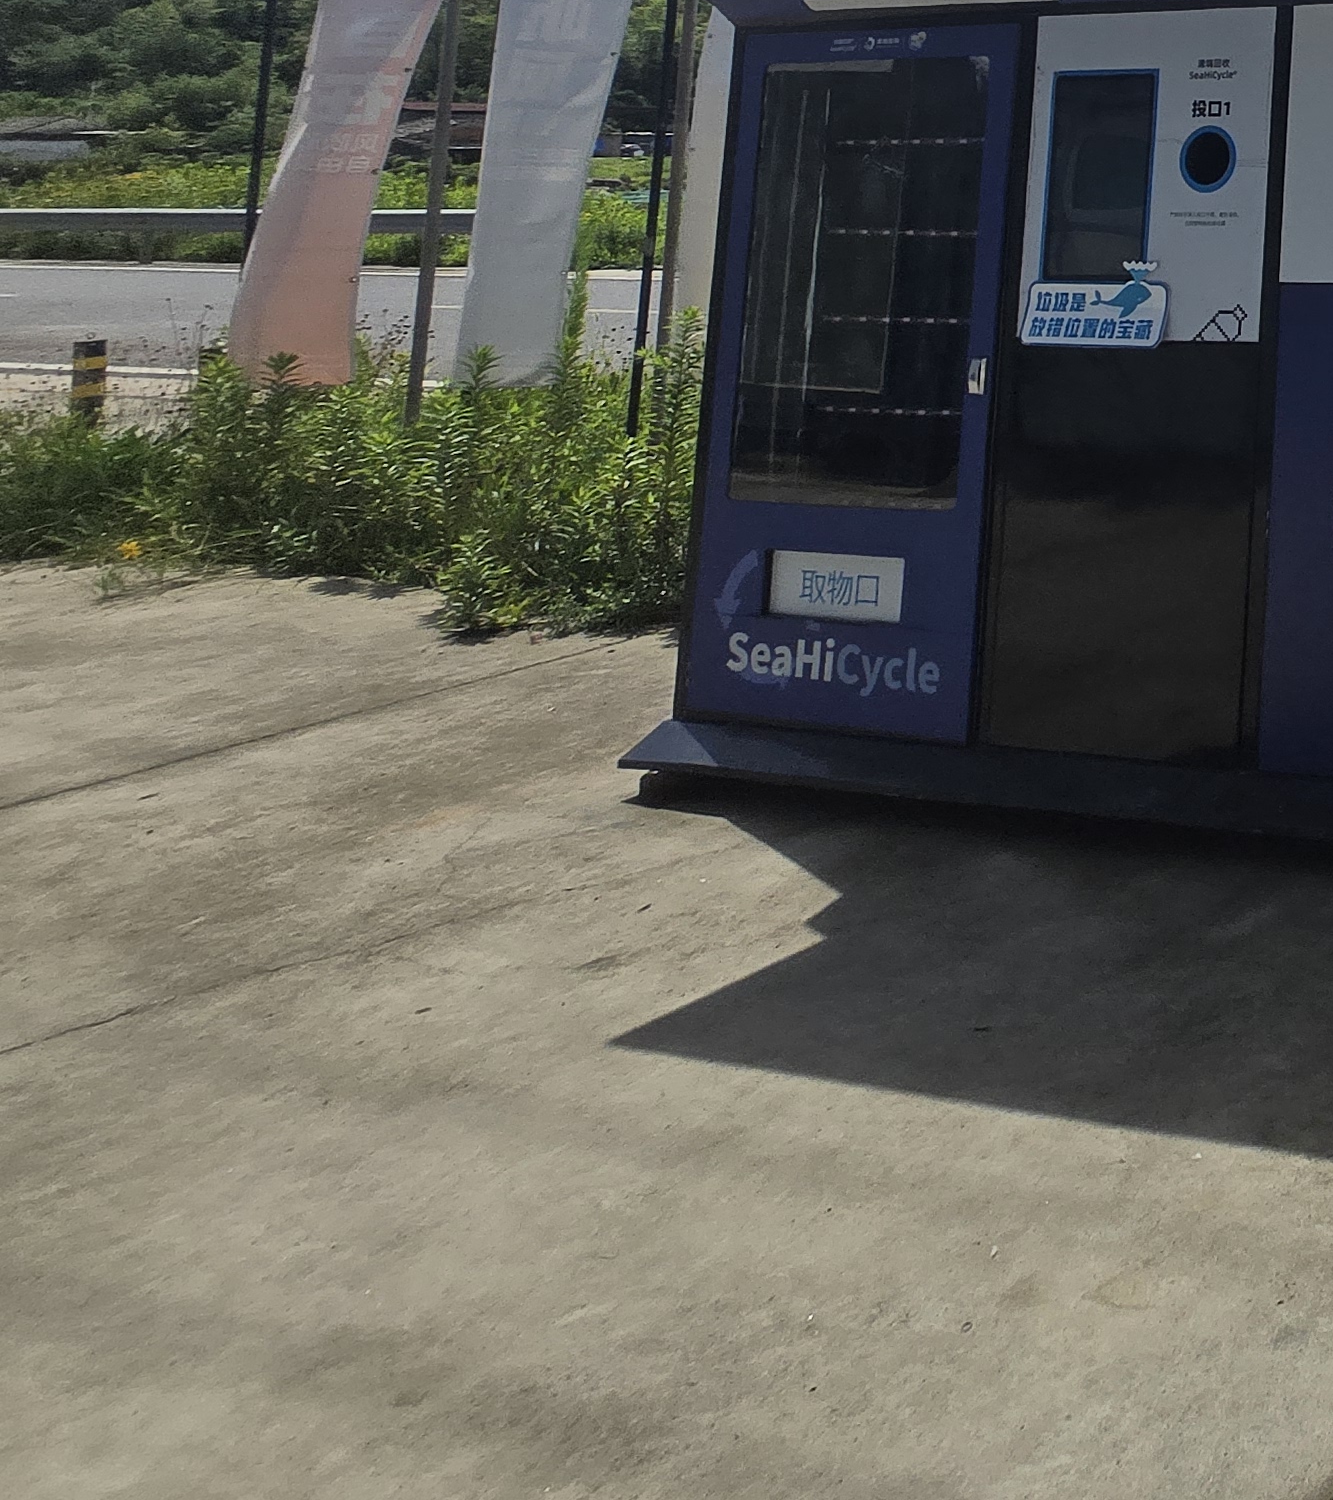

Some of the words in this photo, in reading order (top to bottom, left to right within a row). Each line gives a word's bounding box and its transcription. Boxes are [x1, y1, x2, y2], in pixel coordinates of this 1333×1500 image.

[1190, 99, 1232, 119] 投口1
[1035, 291, 1086, 312] 垃圾是
[1028, 317, 1154, 341] 放错位置的宝藏
[798, 568, 880, 607] 取物口
[725, 631, 940, 697] SeaHiCycle
